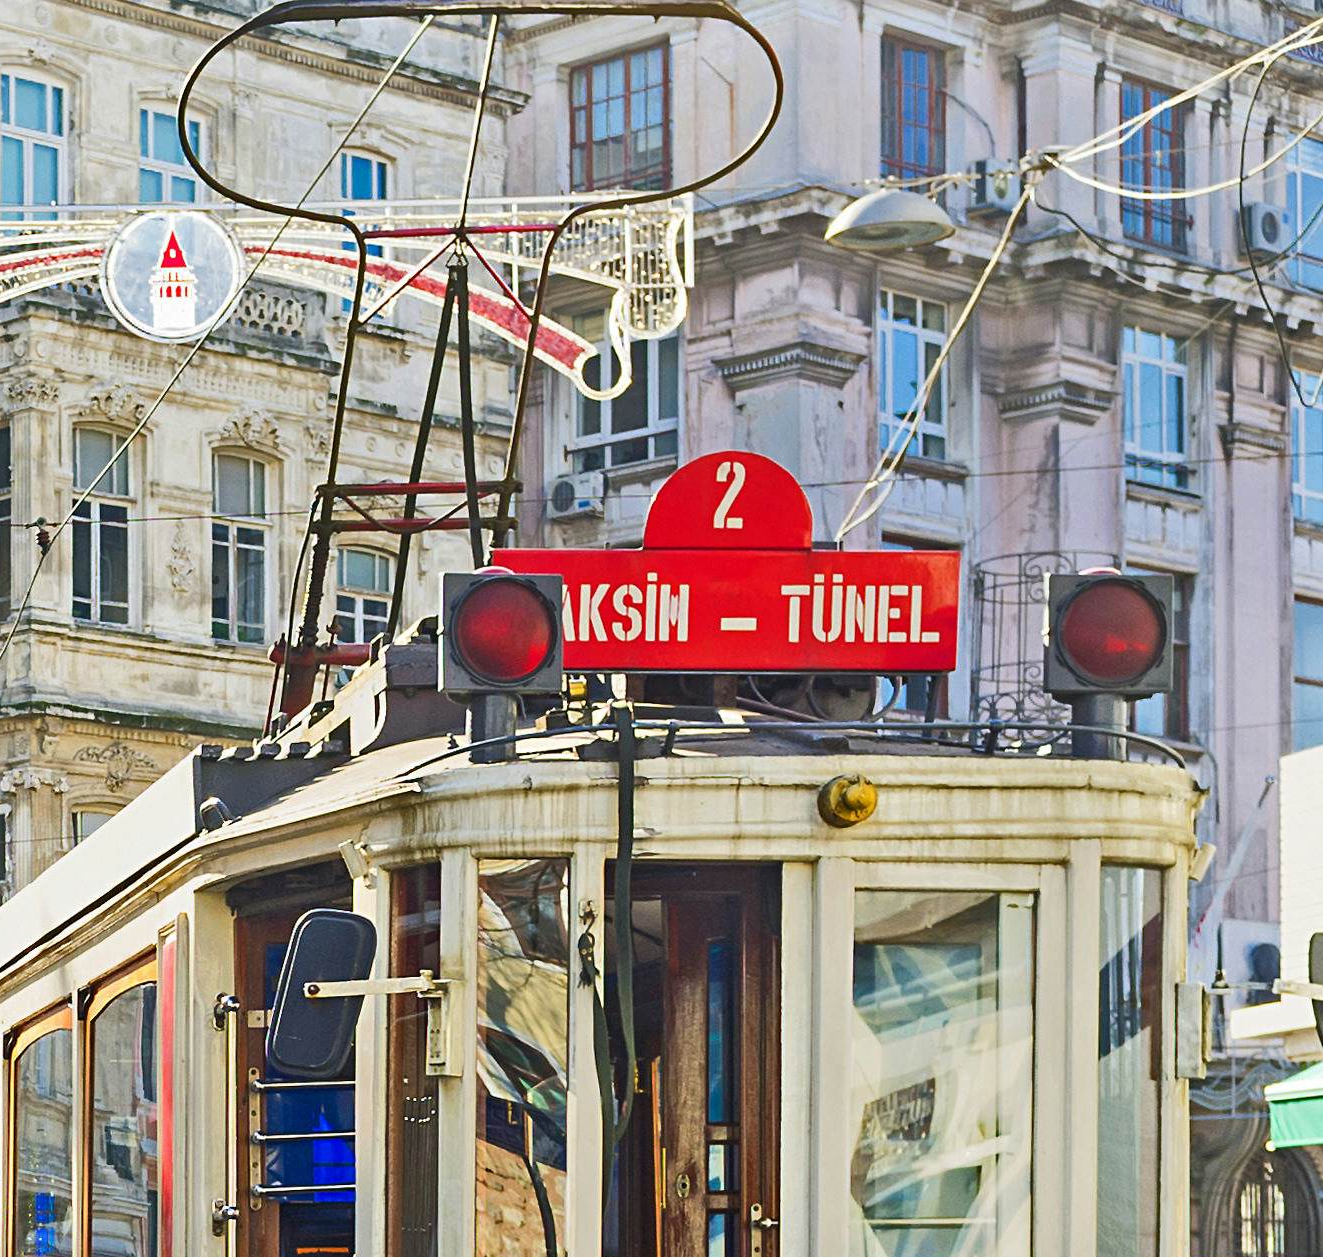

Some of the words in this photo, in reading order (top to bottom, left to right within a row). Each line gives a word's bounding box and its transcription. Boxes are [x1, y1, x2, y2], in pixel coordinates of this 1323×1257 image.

[712, 461, 746, 529] 2
[562, 572, 690, 642] AKSİM
[781, 573, 940, 643] TÜNEL
